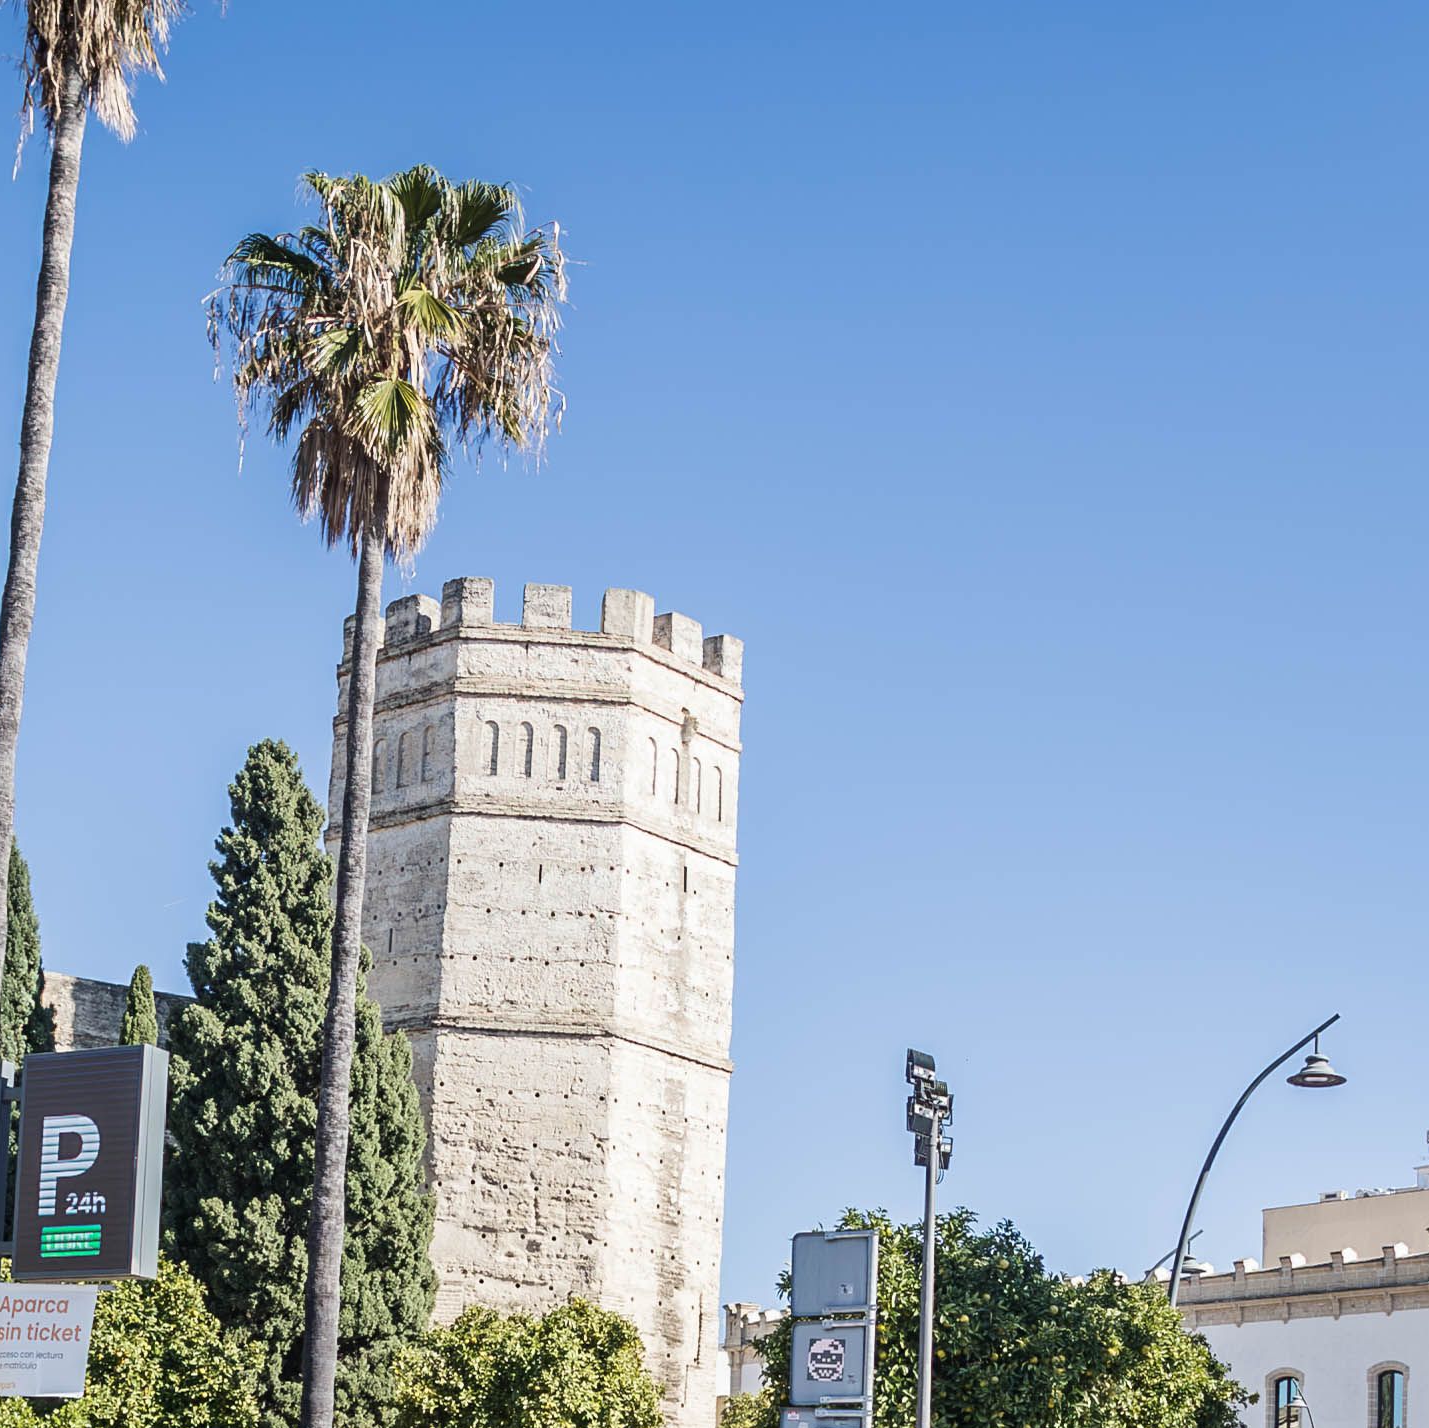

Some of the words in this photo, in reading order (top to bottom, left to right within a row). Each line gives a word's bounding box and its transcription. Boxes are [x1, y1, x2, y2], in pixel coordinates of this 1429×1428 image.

[38, 1113, 101, 1216] P
[65, 1192, 107, 1215] 24h
[27, 1321, 83, 1343] ticket
[20, 1351, 34, 1359] con
[35, 1350, 64, 1360] lectura
